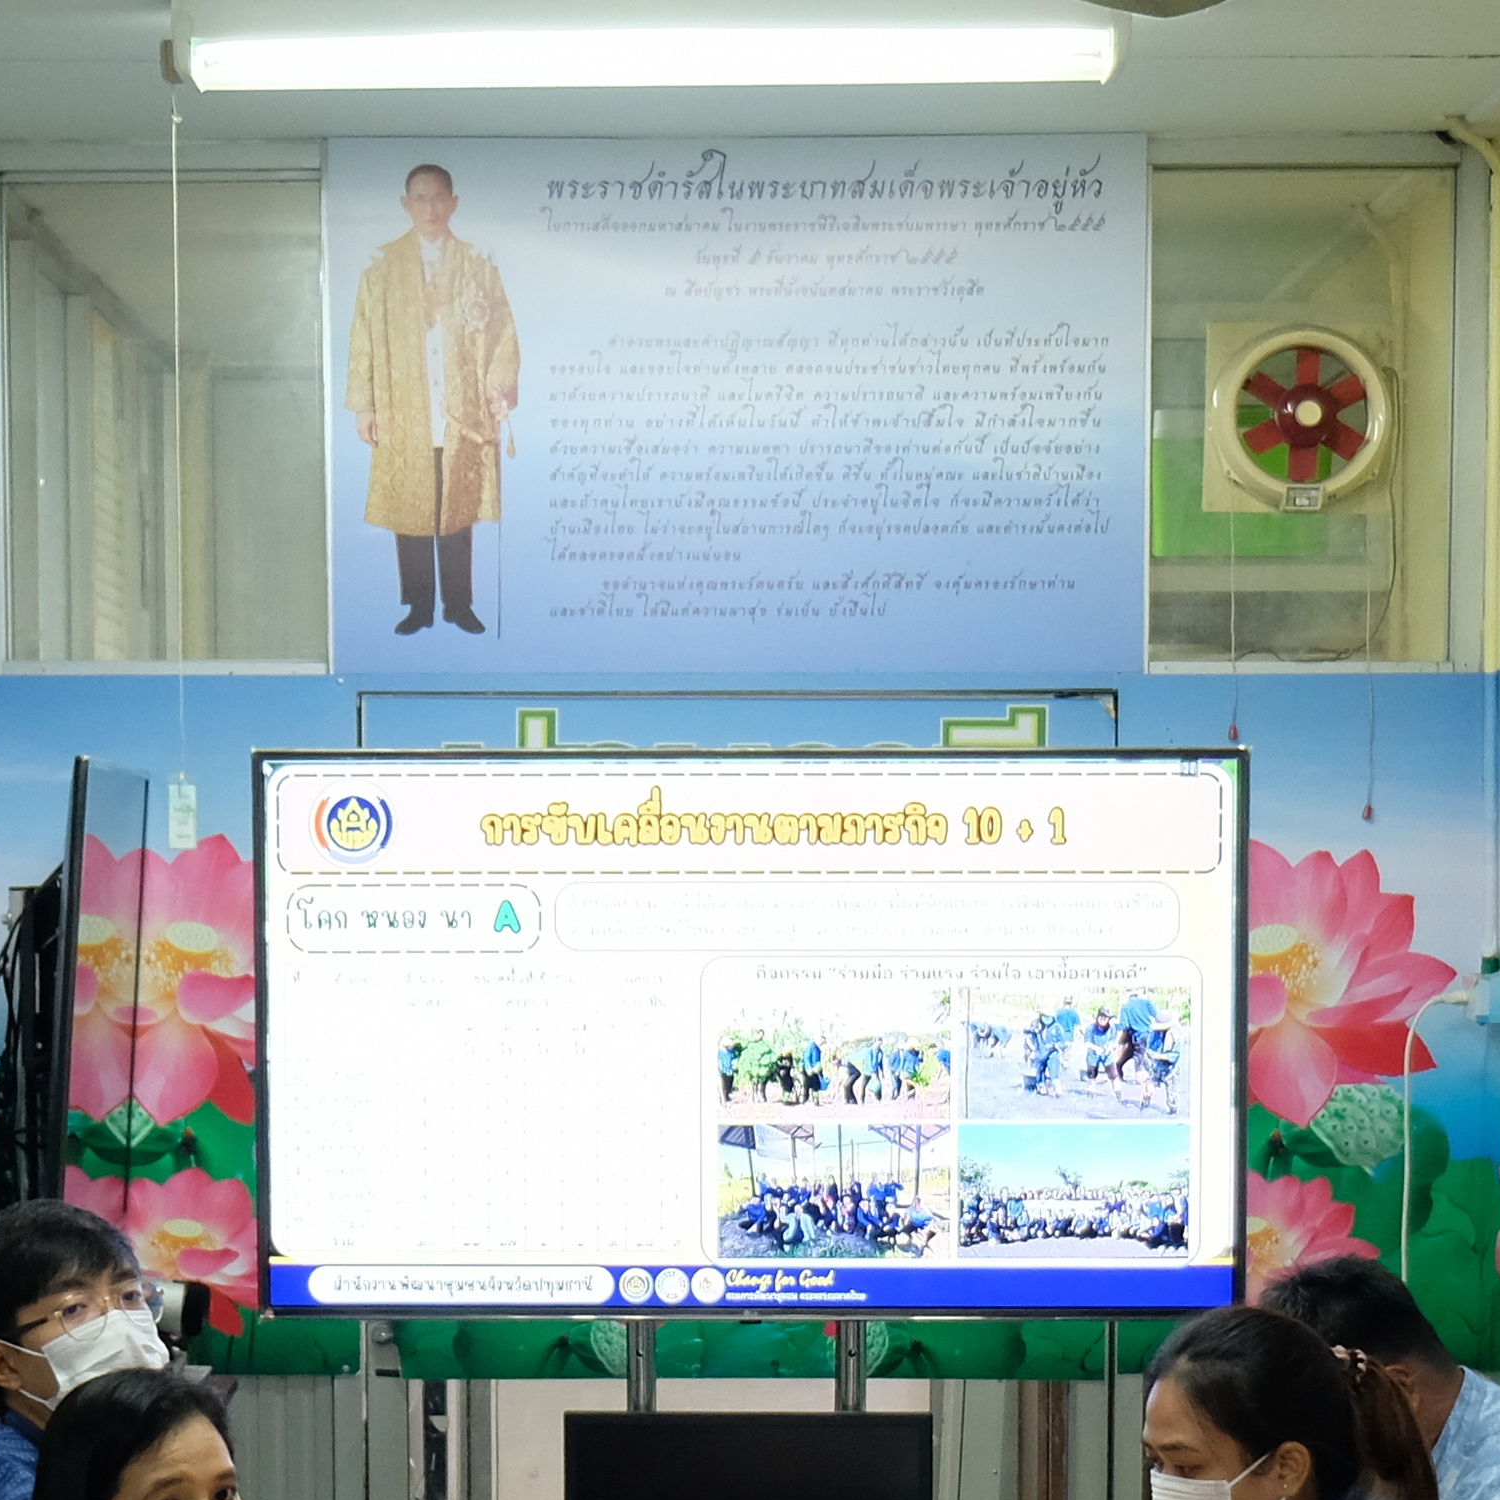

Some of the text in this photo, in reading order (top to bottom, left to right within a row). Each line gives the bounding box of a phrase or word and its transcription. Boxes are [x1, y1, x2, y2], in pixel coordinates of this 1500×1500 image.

[547, 149, 1102, 214] พระราชดำรัสในพระบาทสมเด็จพระเจ้าอยู่หัว
[480, 785, 947, 846] การขับเคลื่อนงานตามภารกิจ
[962, 806, 1002, 845] 10
[1049, 806, 1067, 845] 1
[296, 896, 521, 933] โคก หนอง นา A
